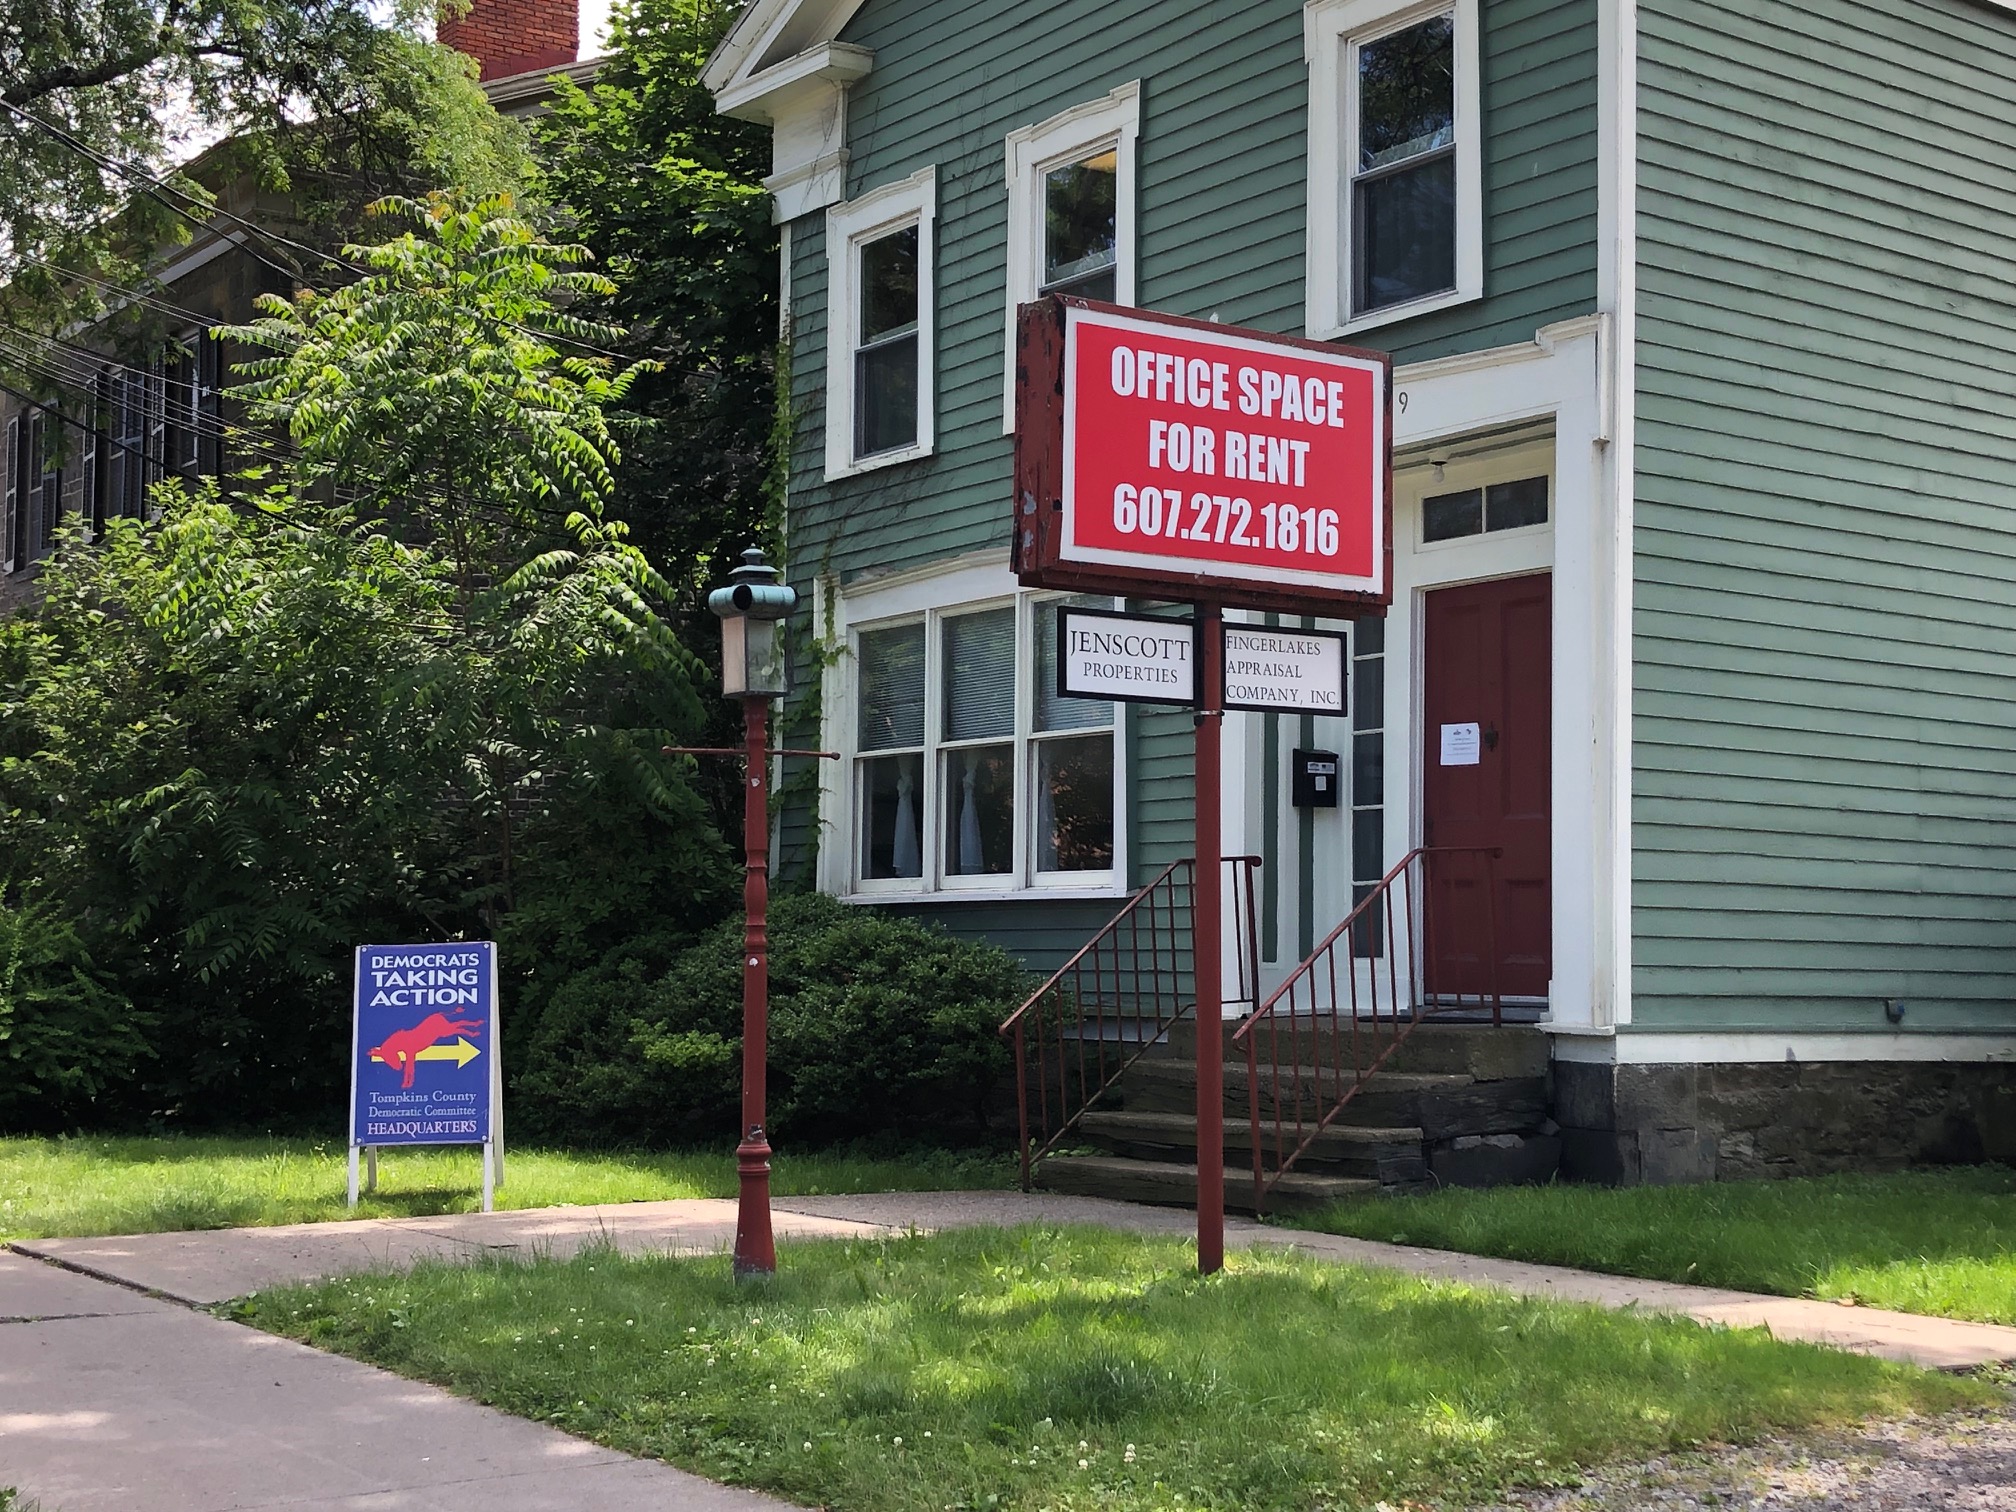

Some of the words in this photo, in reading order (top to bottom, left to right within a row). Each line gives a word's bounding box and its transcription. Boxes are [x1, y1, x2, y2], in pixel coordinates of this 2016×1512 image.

[1110, 345, 1230, 412] OFFICE
[1237, 366, 1345, 429] SPACE
[1398, 391, 1409, 415] 9
[1149, 419, 1215, 476] FOR
[1224, 430, 1311, 488] RENT
[1113, 482, 1340, 557] 607.272.1816
[1070, 629, 1190, 661] JENSCOTT
[1226, 635, 1321, 656] FINGERLAKES
[1083, 661, 1178, 684] PROPERTIES
[1226, 660, 1303, 679] APPRAISAL
[1226, 684, 1303, 706] COMPANY,
[1310, 689, 1340, 705] INC.
[371, 952, 480, 970] DEMOCRATS
[370, 969, 479, 988] TAKING
[369, 987, 478, 1007] ACTION
[369, 1091, 429, 1106] Tompkins
[432, 1090, 478, 1104] County
[368, 1105, 422, 1118] Democratic
[424, 1105, 477, 1117] Committee
[367, 1120, 477, 1139] HEADQUARTERS
